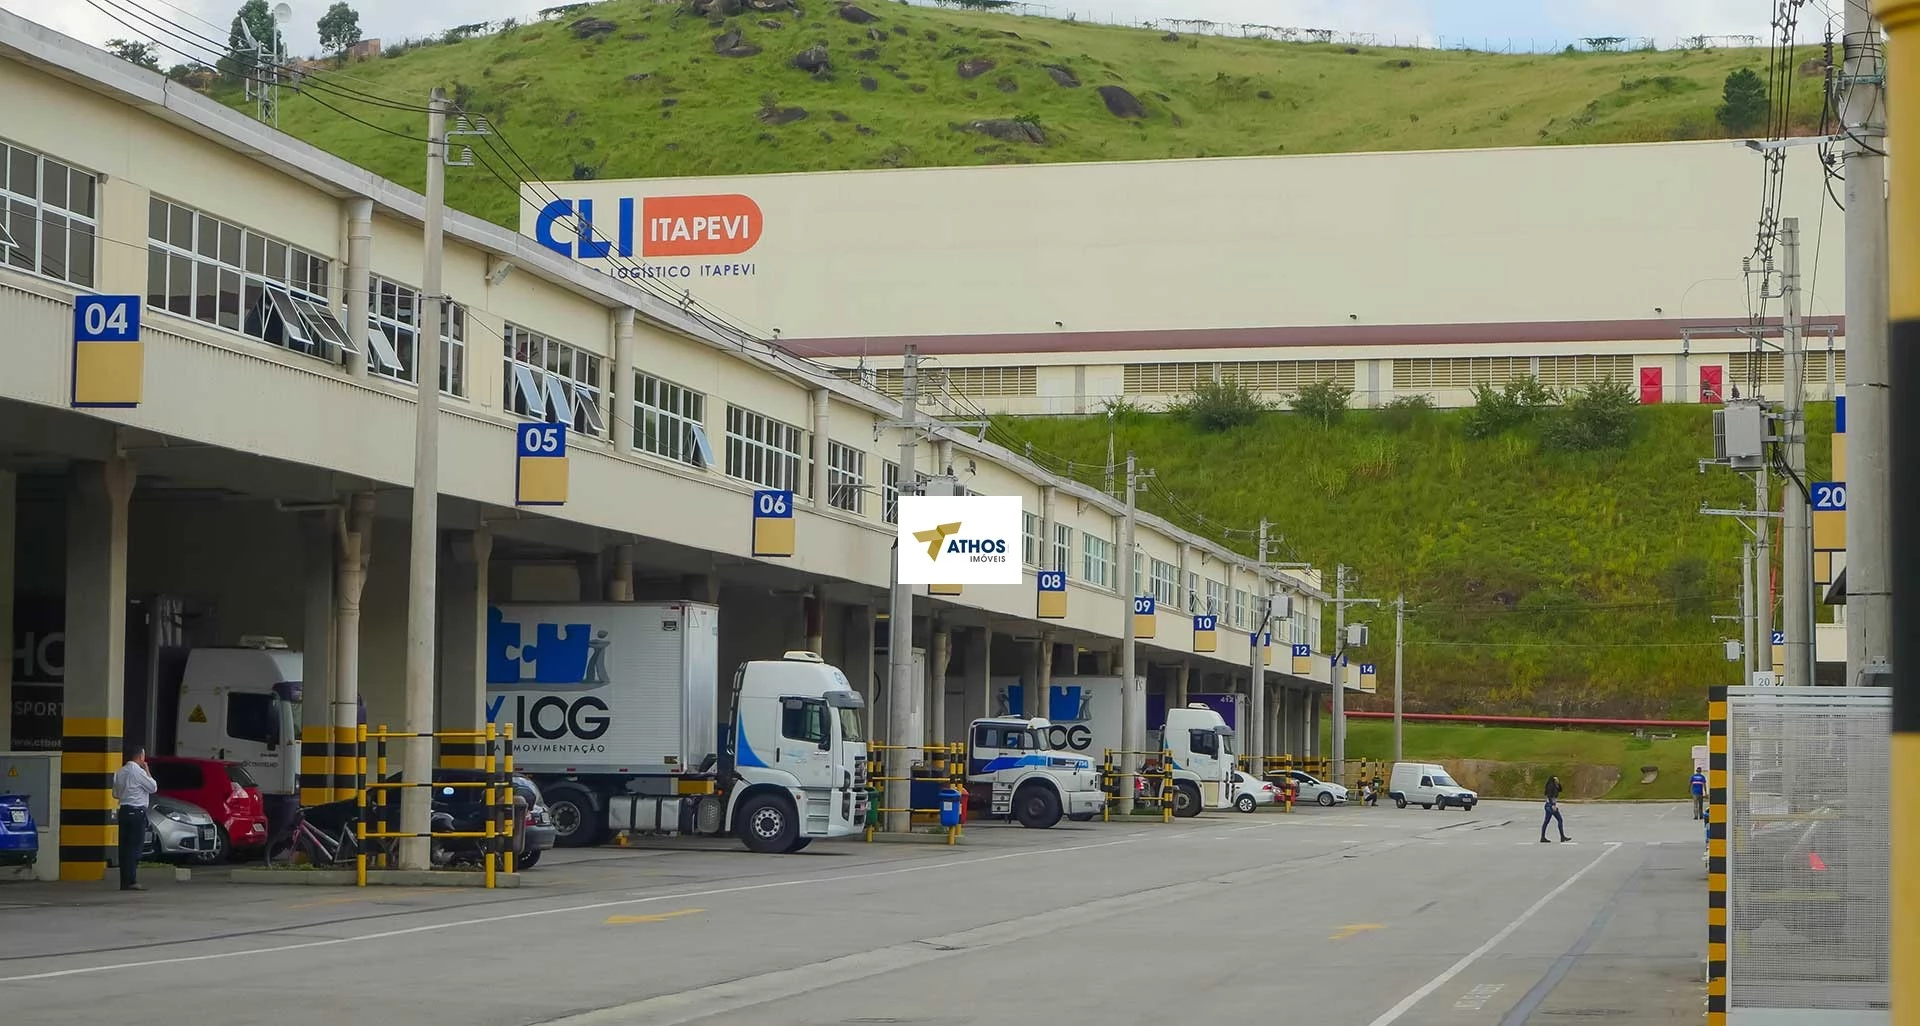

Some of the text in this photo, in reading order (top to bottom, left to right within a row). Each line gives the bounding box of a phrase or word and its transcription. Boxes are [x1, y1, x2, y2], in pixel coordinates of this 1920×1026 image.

[535, 197, 749, 259] CLI ITAPEVI
[610, 263, 756, 279] LOGÍSTICO ITAPEVI
[84, 302, 128, 336] 04
[525, 427, 558, 452] 05
[760, 494, 786, 514] 06
[1817, 486, 1847, 508] 20
[1041, 574, 1061, 589] 08
[1134, 600, 1151, 613] 09
[1197, 618, 1212, 630] 10
[1295, 647, 1308, 656] 12
[1361, 665, 1373, 674] 14
[1758, 677, 1770, 687] 20
[517, 695, 611, 740] LOG
[1048, 724, 1092, 751] OG
[513, 744, 605, 754] MOVIMENTAÇÃO
